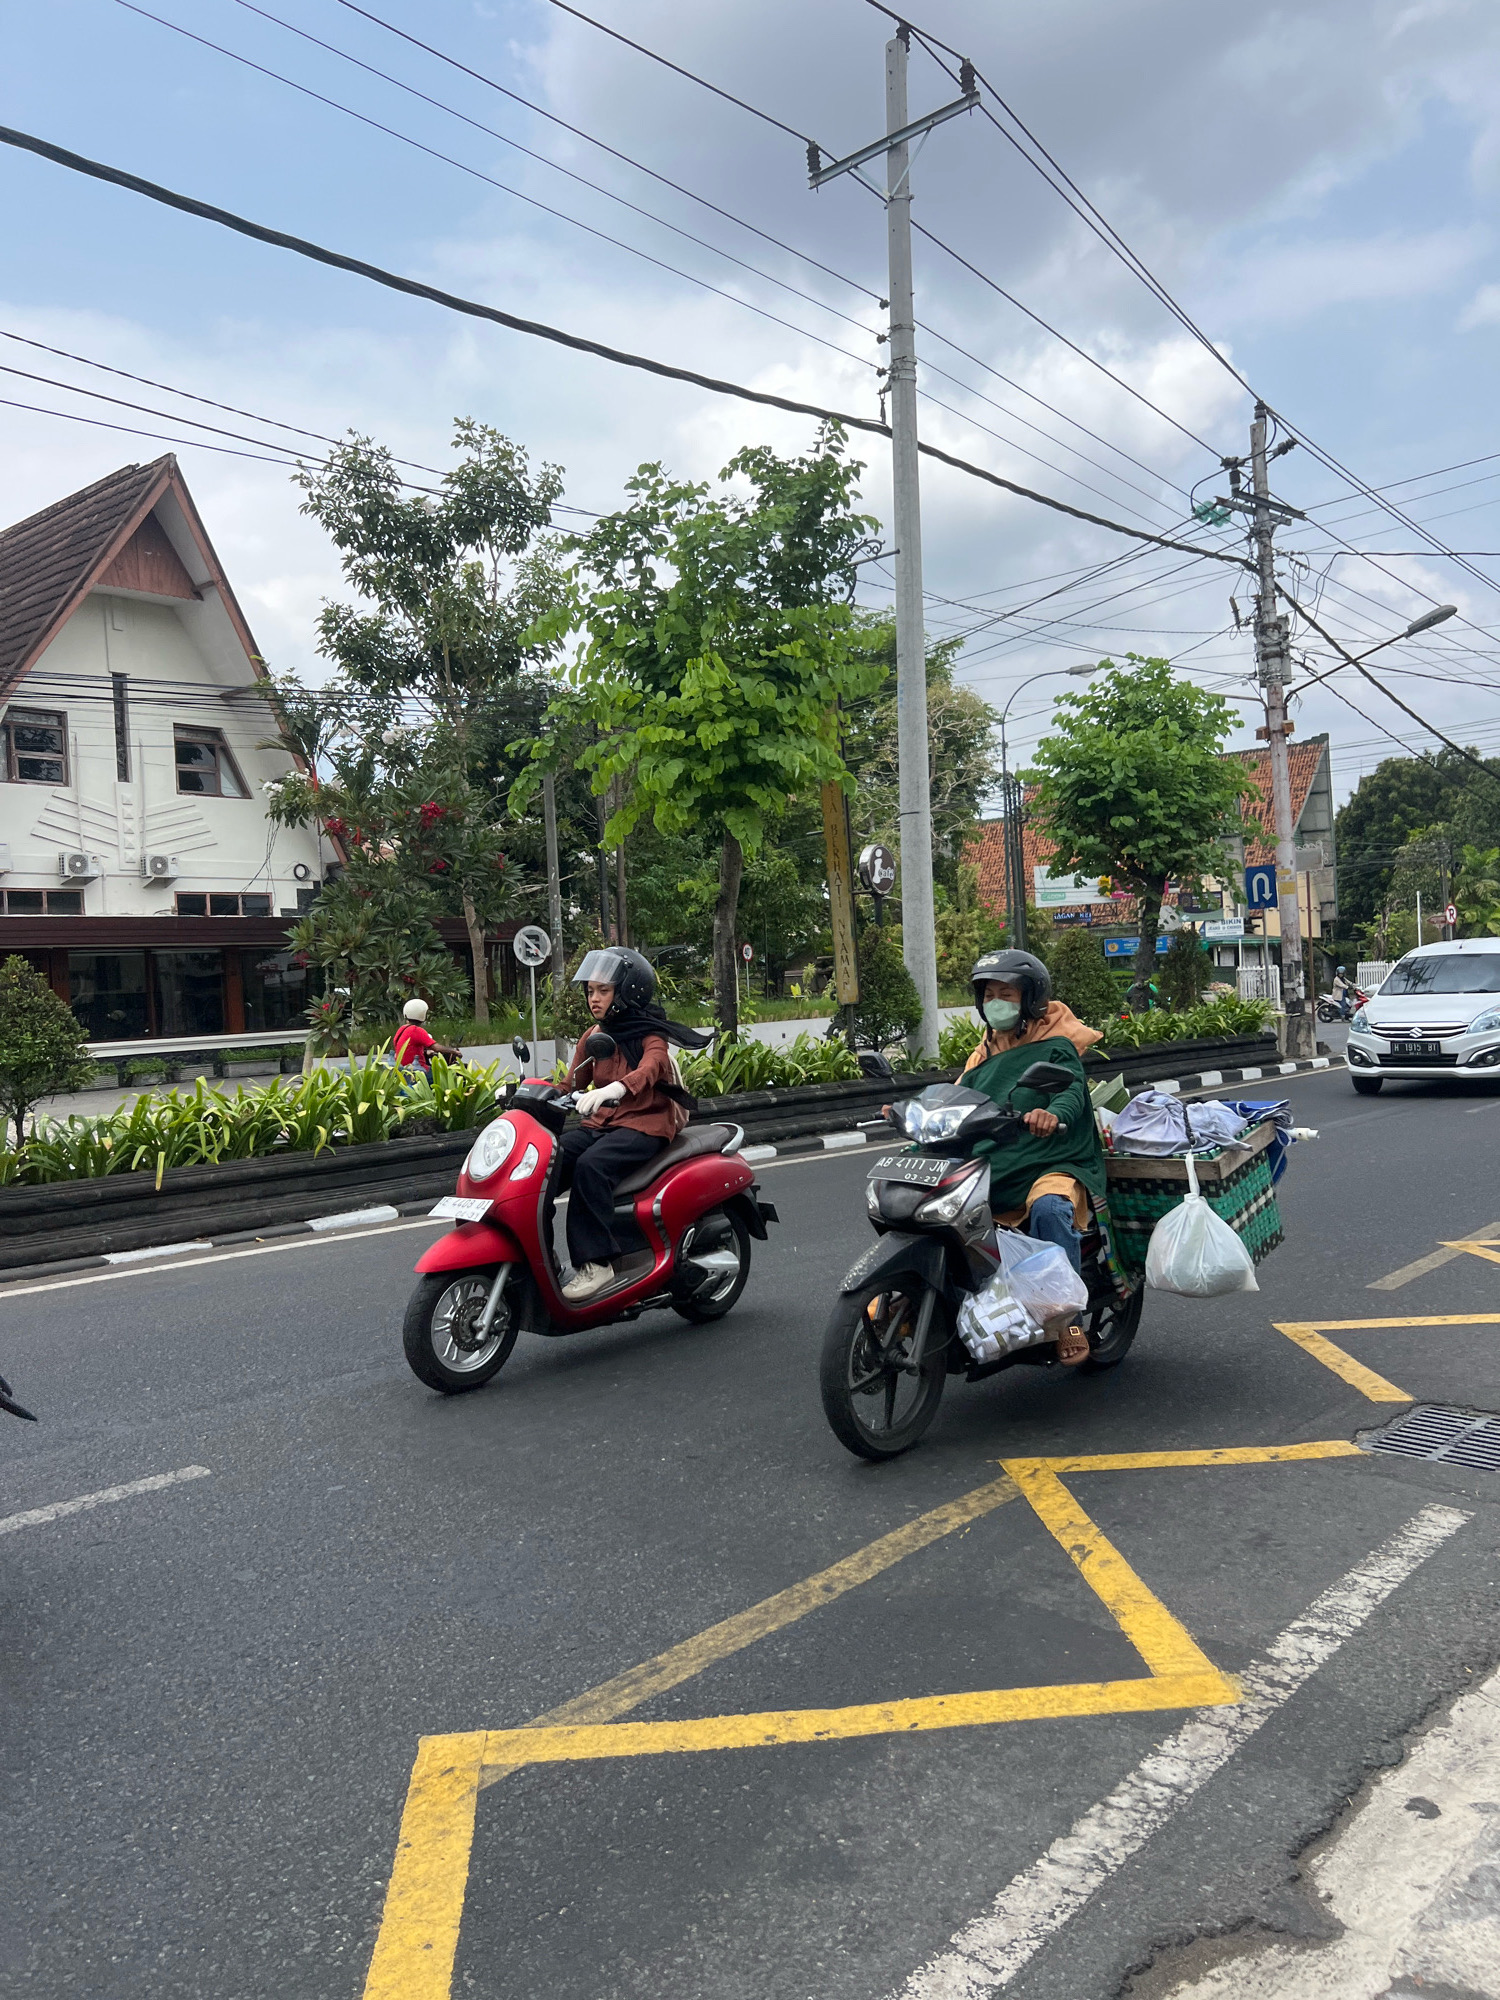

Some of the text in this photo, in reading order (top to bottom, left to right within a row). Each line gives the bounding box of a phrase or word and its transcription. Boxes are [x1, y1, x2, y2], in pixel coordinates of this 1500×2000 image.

[830, 823, 843, 908] BERHATI
[1394, 1043, 1399, 1051] H
[1405, 1043, 1421, 1051] 1915
[876, 1157, 947, 1173] AB 4111 JN
